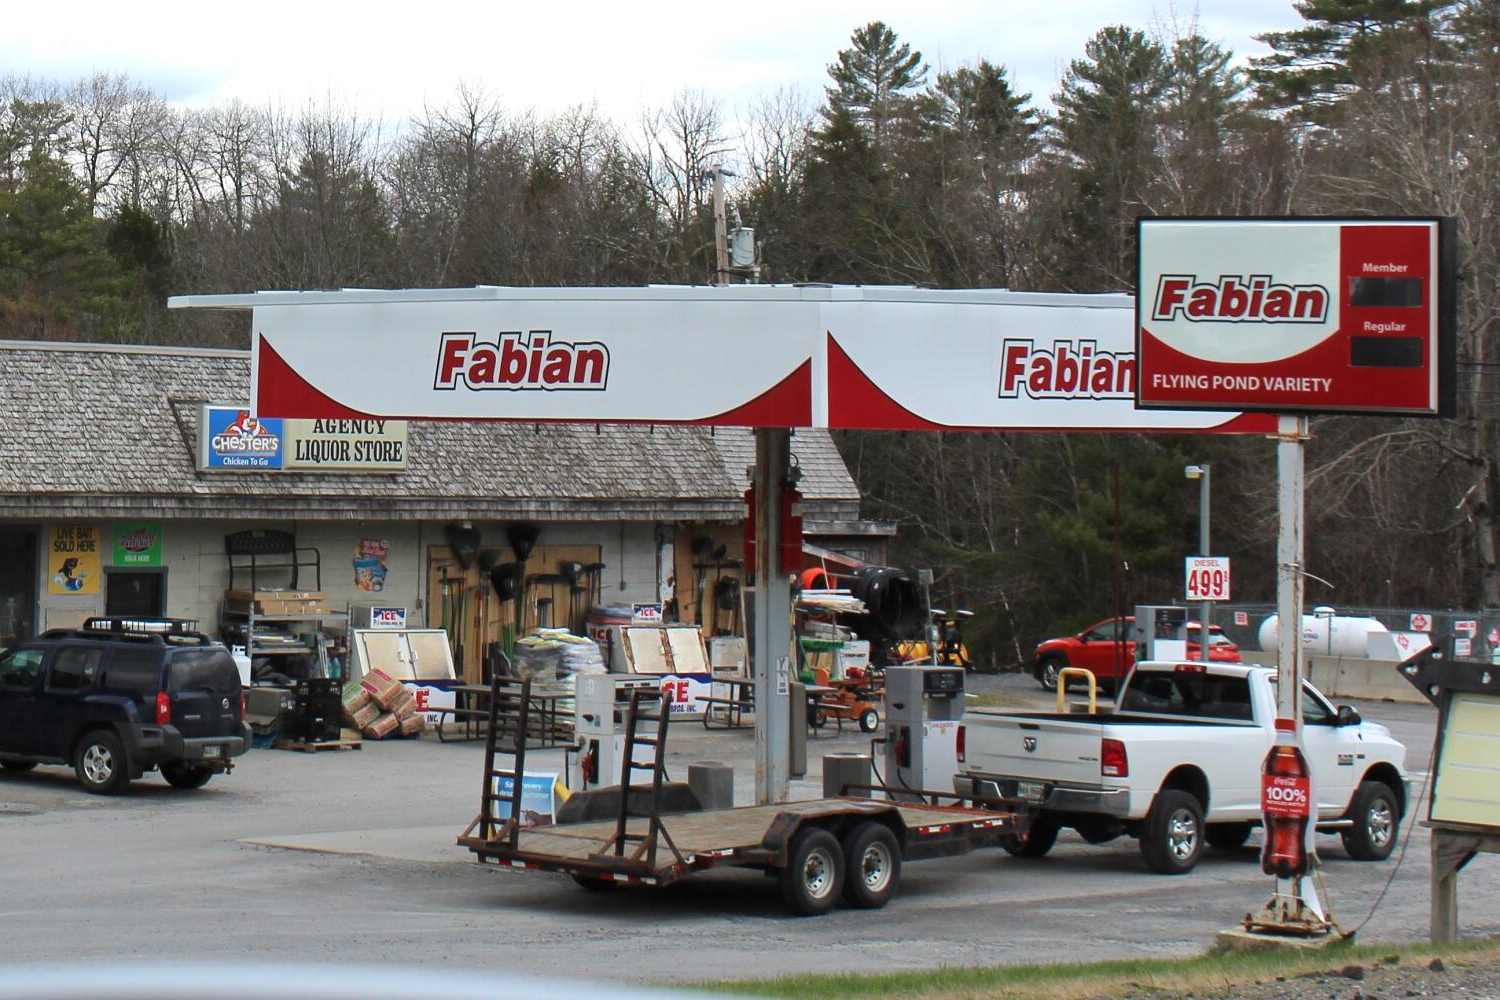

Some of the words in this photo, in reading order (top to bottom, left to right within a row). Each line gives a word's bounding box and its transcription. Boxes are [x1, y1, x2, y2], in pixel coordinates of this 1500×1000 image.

[1362, 262, 1409, 273] Member
[1155, 277, 1328, 321] Fabian
[1363, 321, 1407, 332] Regular
[436, 333, 607, 388] Fabian
[1153, 374, 1209, 389] FLYING
[1212, 376, 1261, 391] POND
[1264, 377, 1332, 392] VARIETY
[313, 419, 386, 434] AGENCY
[295, 439, 351, 463] LIQUOR
[354, 441, 403, 462] STORE
[222, 456, 249, 466] Chicken
[250, 457, 260, 466] To
[261, 457, 269, 466] Go
[56, 527, 75, 539] LIVE
[76, 527, 92, 539] BAIT
[53, 540, 75, 552] SOLD
[76, 541, 96, 552] HERE
[1194, 559, 1220, 567] DIESEL
[381, 611, 397, 621] ICE
[640, 609, 654, 617] ICE
[426, 713, 439, 723] INC.
[1266, 786, 1307, 803] 100%
